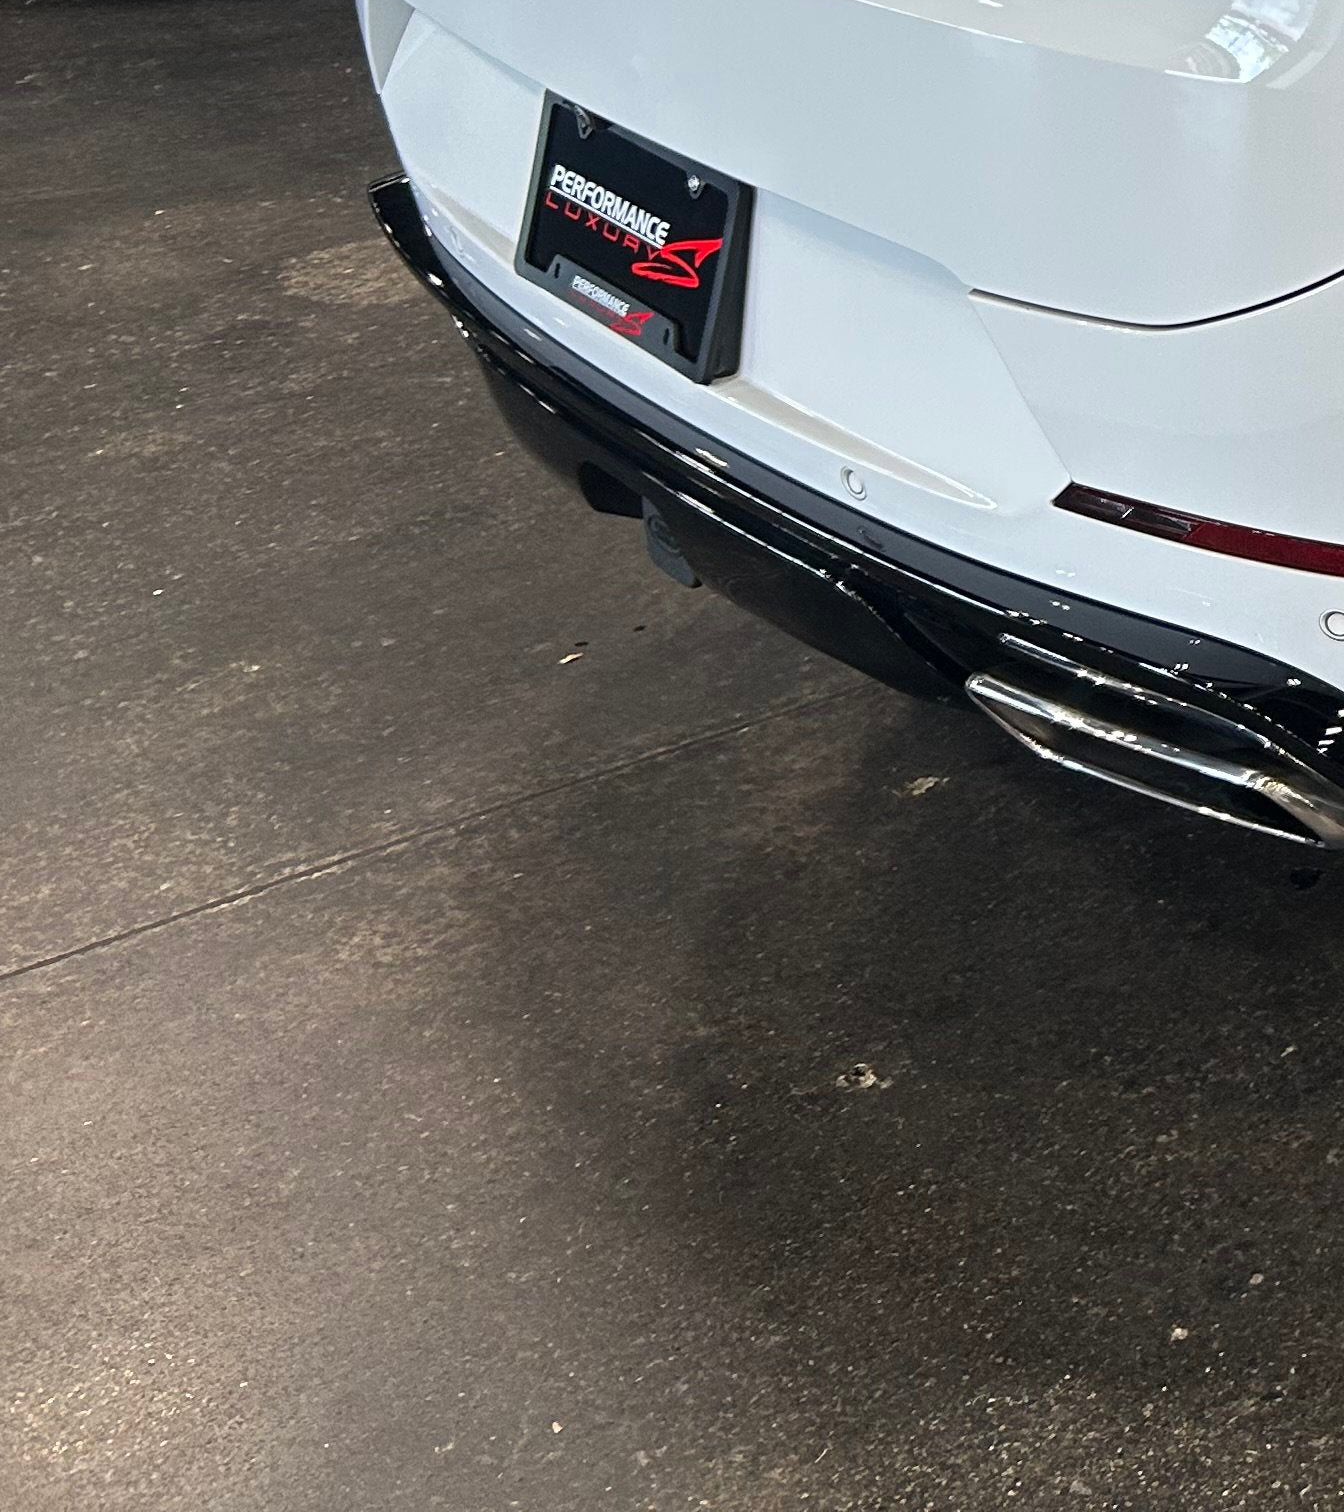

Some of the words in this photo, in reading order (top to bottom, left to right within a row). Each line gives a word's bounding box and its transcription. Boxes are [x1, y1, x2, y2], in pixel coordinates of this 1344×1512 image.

[544, 192, 663, 261] LUXURY
[550, 164, 671, 246] PERFORMANCE
[571, 275, 631, 314] PERFORMANCE
